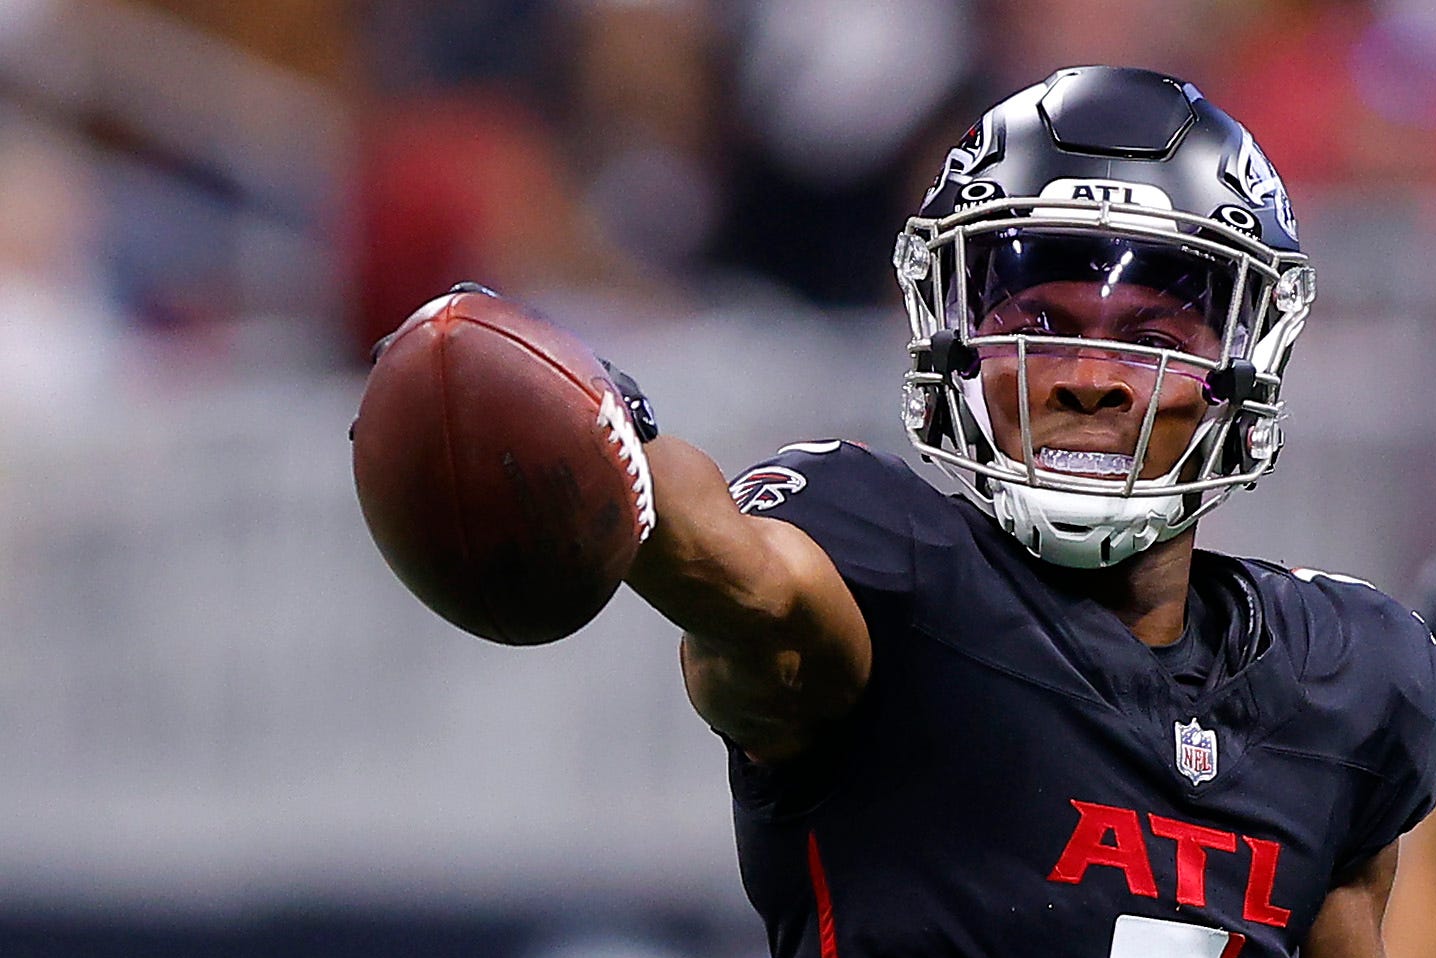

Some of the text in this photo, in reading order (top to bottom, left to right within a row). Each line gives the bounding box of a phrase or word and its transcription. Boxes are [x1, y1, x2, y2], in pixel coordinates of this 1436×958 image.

[1072, 185, 1140, 206] ATL
[1184, 746, 1212, 772] NFL
[1047, 799, 1291, 928] ATL
